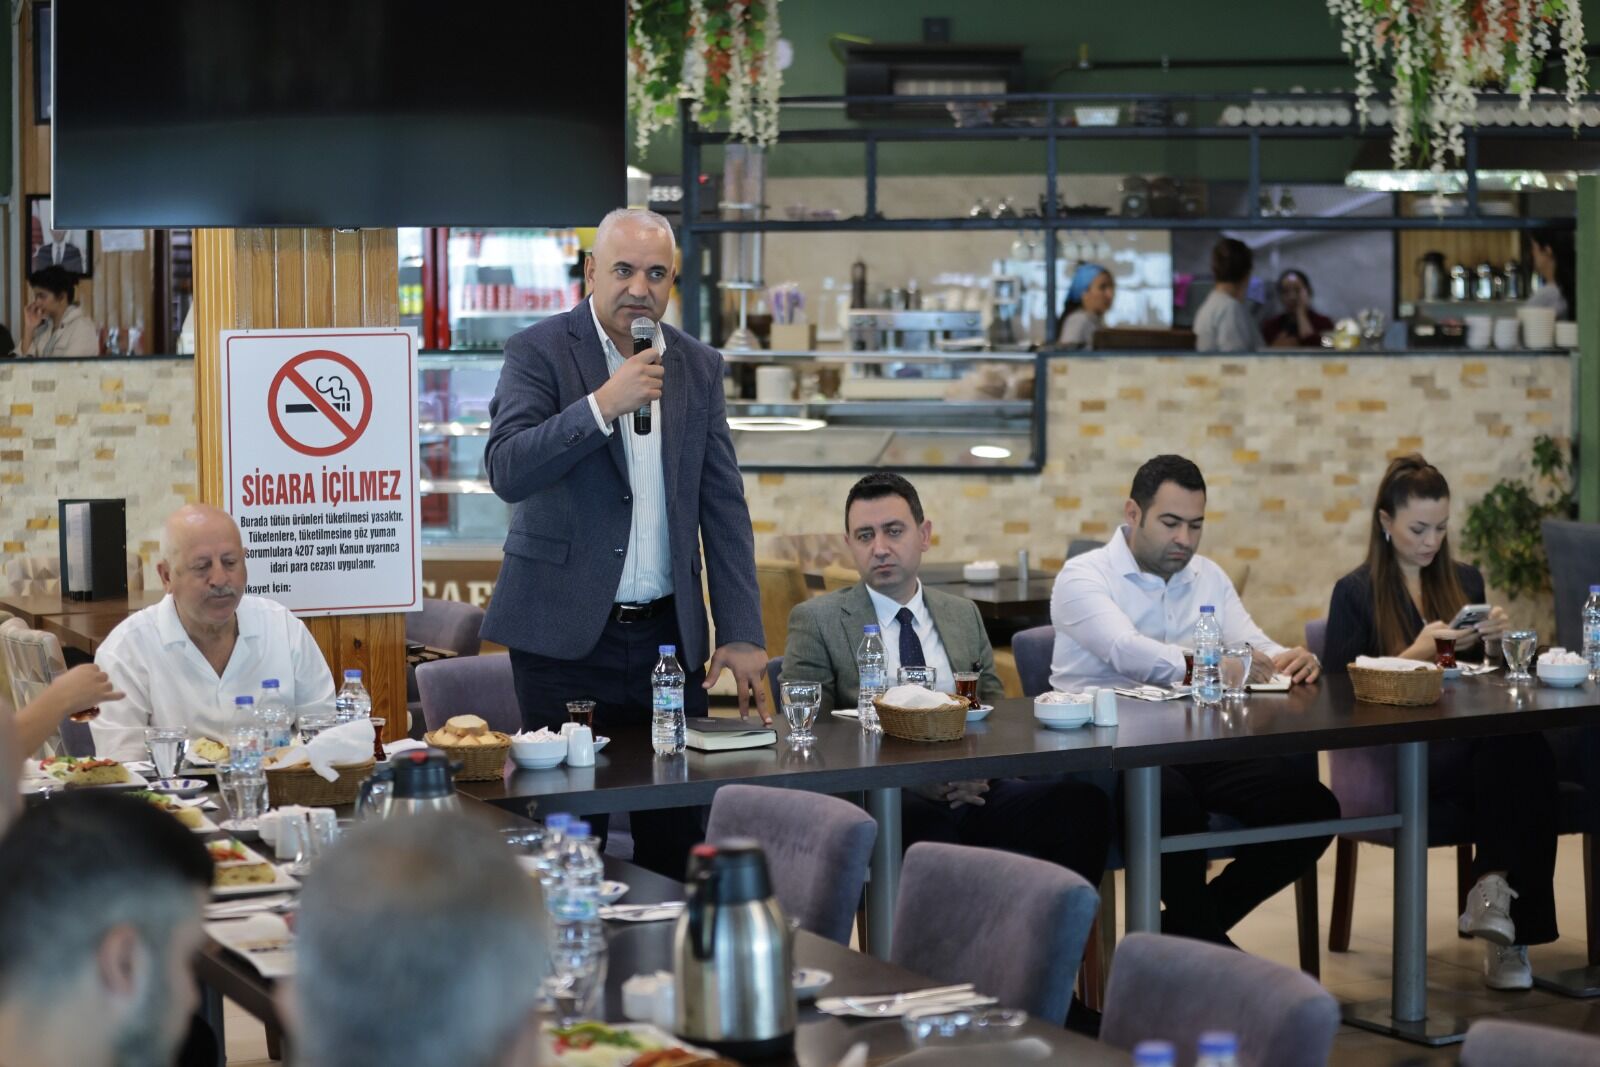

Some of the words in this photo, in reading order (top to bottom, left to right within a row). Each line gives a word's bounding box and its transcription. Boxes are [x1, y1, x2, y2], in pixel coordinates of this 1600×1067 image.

[242, 467, 316, 507] SİGARA
[322, 464, 402, 508] İÇİLMEZ
[240, 516, 268, 528] Burada
[270, 514, 291, 527] tütün
[292, 513, 324, 526] ürünleri
[325, 511, 369, 524] tüketilmesi
[371, 510, 404, 523] yasaktır.
[248, 529, 297, 543] Tüketenlere,
[299, 526, 352, 541] tüketilmesine
[354, 527, 368, 542] göz
[370, 527, 396, 540] yuman
[294, 545, 315, 556] 4207
[316, 543, 337, 557] sayılı
[339, 543, 364, 555] Kanun
[366, 543, 400, 555] uyarınca
[290, 561, 308, 574] para
[310, 559, 336, 572] cezası
[337, 558, 376, 572] uygulanır.
[272, 582, 291, 594] İçin:
[422, 579, 497, 607] AF
